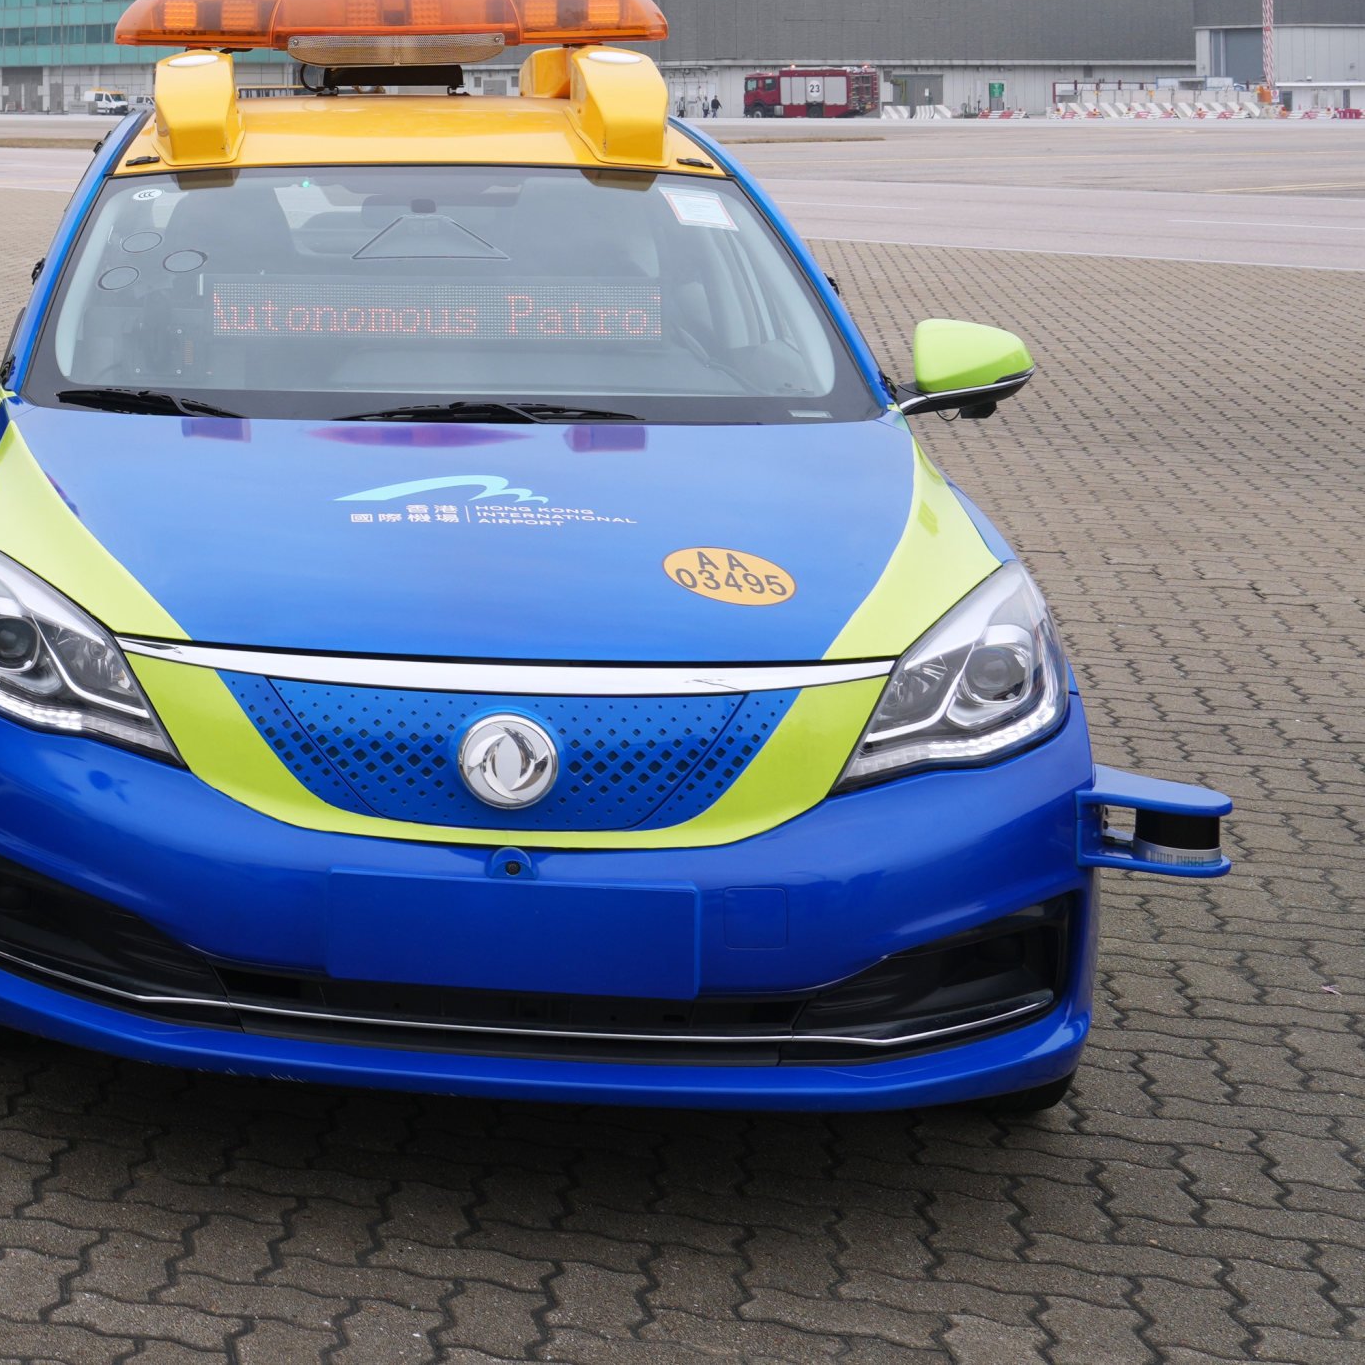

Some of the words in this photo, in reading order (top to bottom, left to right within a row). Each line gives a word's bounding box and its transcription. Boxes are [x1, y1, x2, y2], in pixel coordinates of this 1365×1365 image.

[809, 84, 820, 93] 23
[406, 504, 457, 514] 香港
[538, 507, 594, 515] KONG
[351, 513, 460, 523] 國際機場
[476, 511, 638, 524] INTERNATIONAL
[478, 518, 564, 526] AIRPORT
[675, 568, 787, 596] 03495
